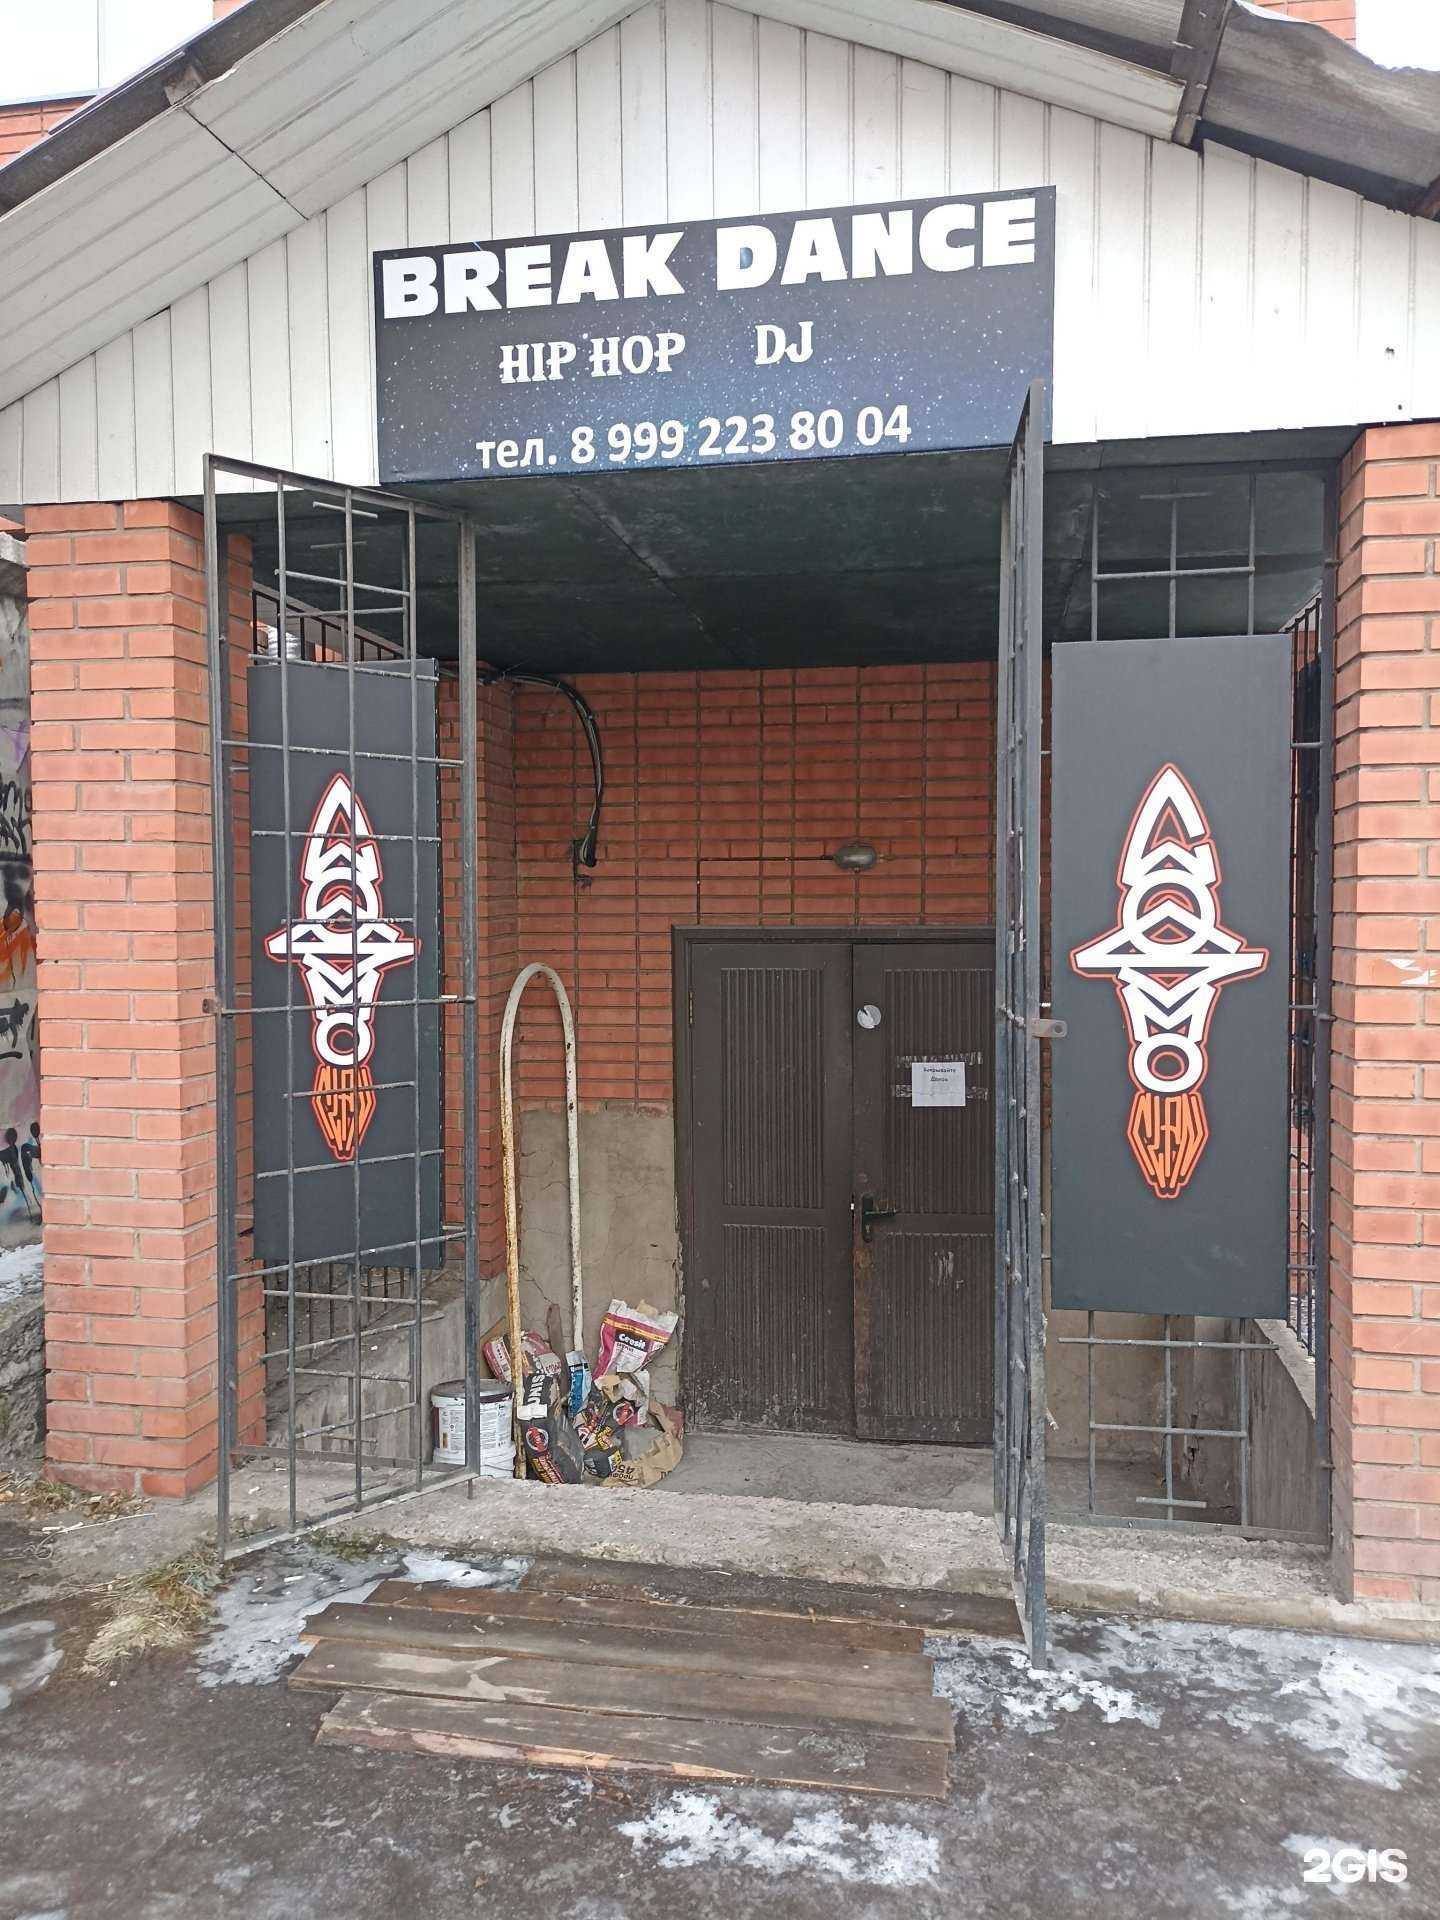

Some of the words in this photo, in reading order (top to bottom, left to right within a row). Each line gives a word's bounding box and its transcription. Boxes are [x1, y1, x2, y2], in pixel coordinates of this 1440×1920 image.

[383, 231, 685, 319] BREAK
[716, 197, 1036, 291] DANCE
[499, 342, 577, 384] HIP
[589, 331, 686, 378] HOP
[754, 321, 814, 365] DJ
[476, 437, 556, 469] тел.
[570, 426, 595, 463] 8
[607, 420, 685, 461] 999
[698, 413, 777, 456] 223
[789, 408, 844, 451] 80
[856, 404, 911, 446] 04
